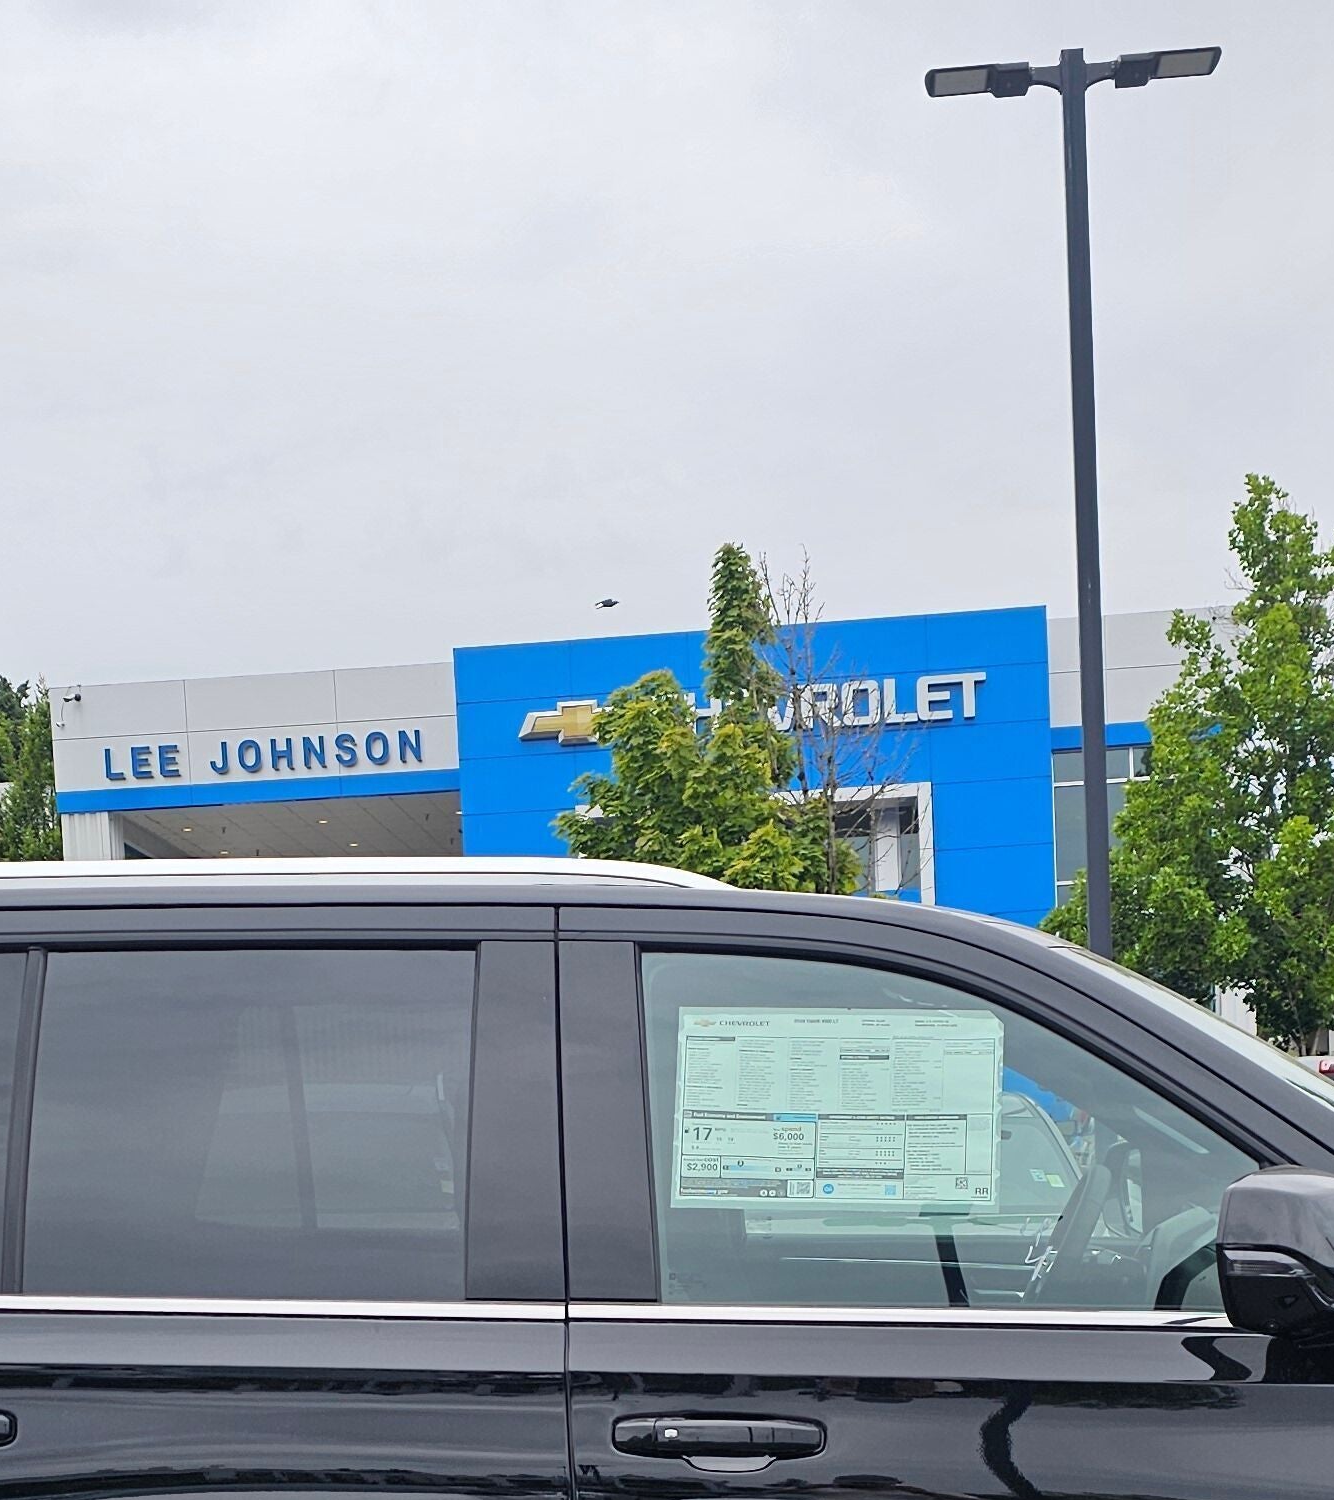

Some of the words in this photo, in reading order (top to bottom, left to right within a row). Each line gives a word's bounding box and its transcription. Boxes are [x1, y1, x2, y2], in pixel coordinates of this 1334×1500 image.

[647, 671, 987, 736] HVROLET
[104, 744, 182, 781] LEE
[210, 729, 423, 775] JOHNSON
[693, 1127, 713, 1141] 17
[773, 1132, 805, 1142] $6,000
[686, 1163, 718, 1173] $2,900
[975, 1187, 989, 1195] RR
